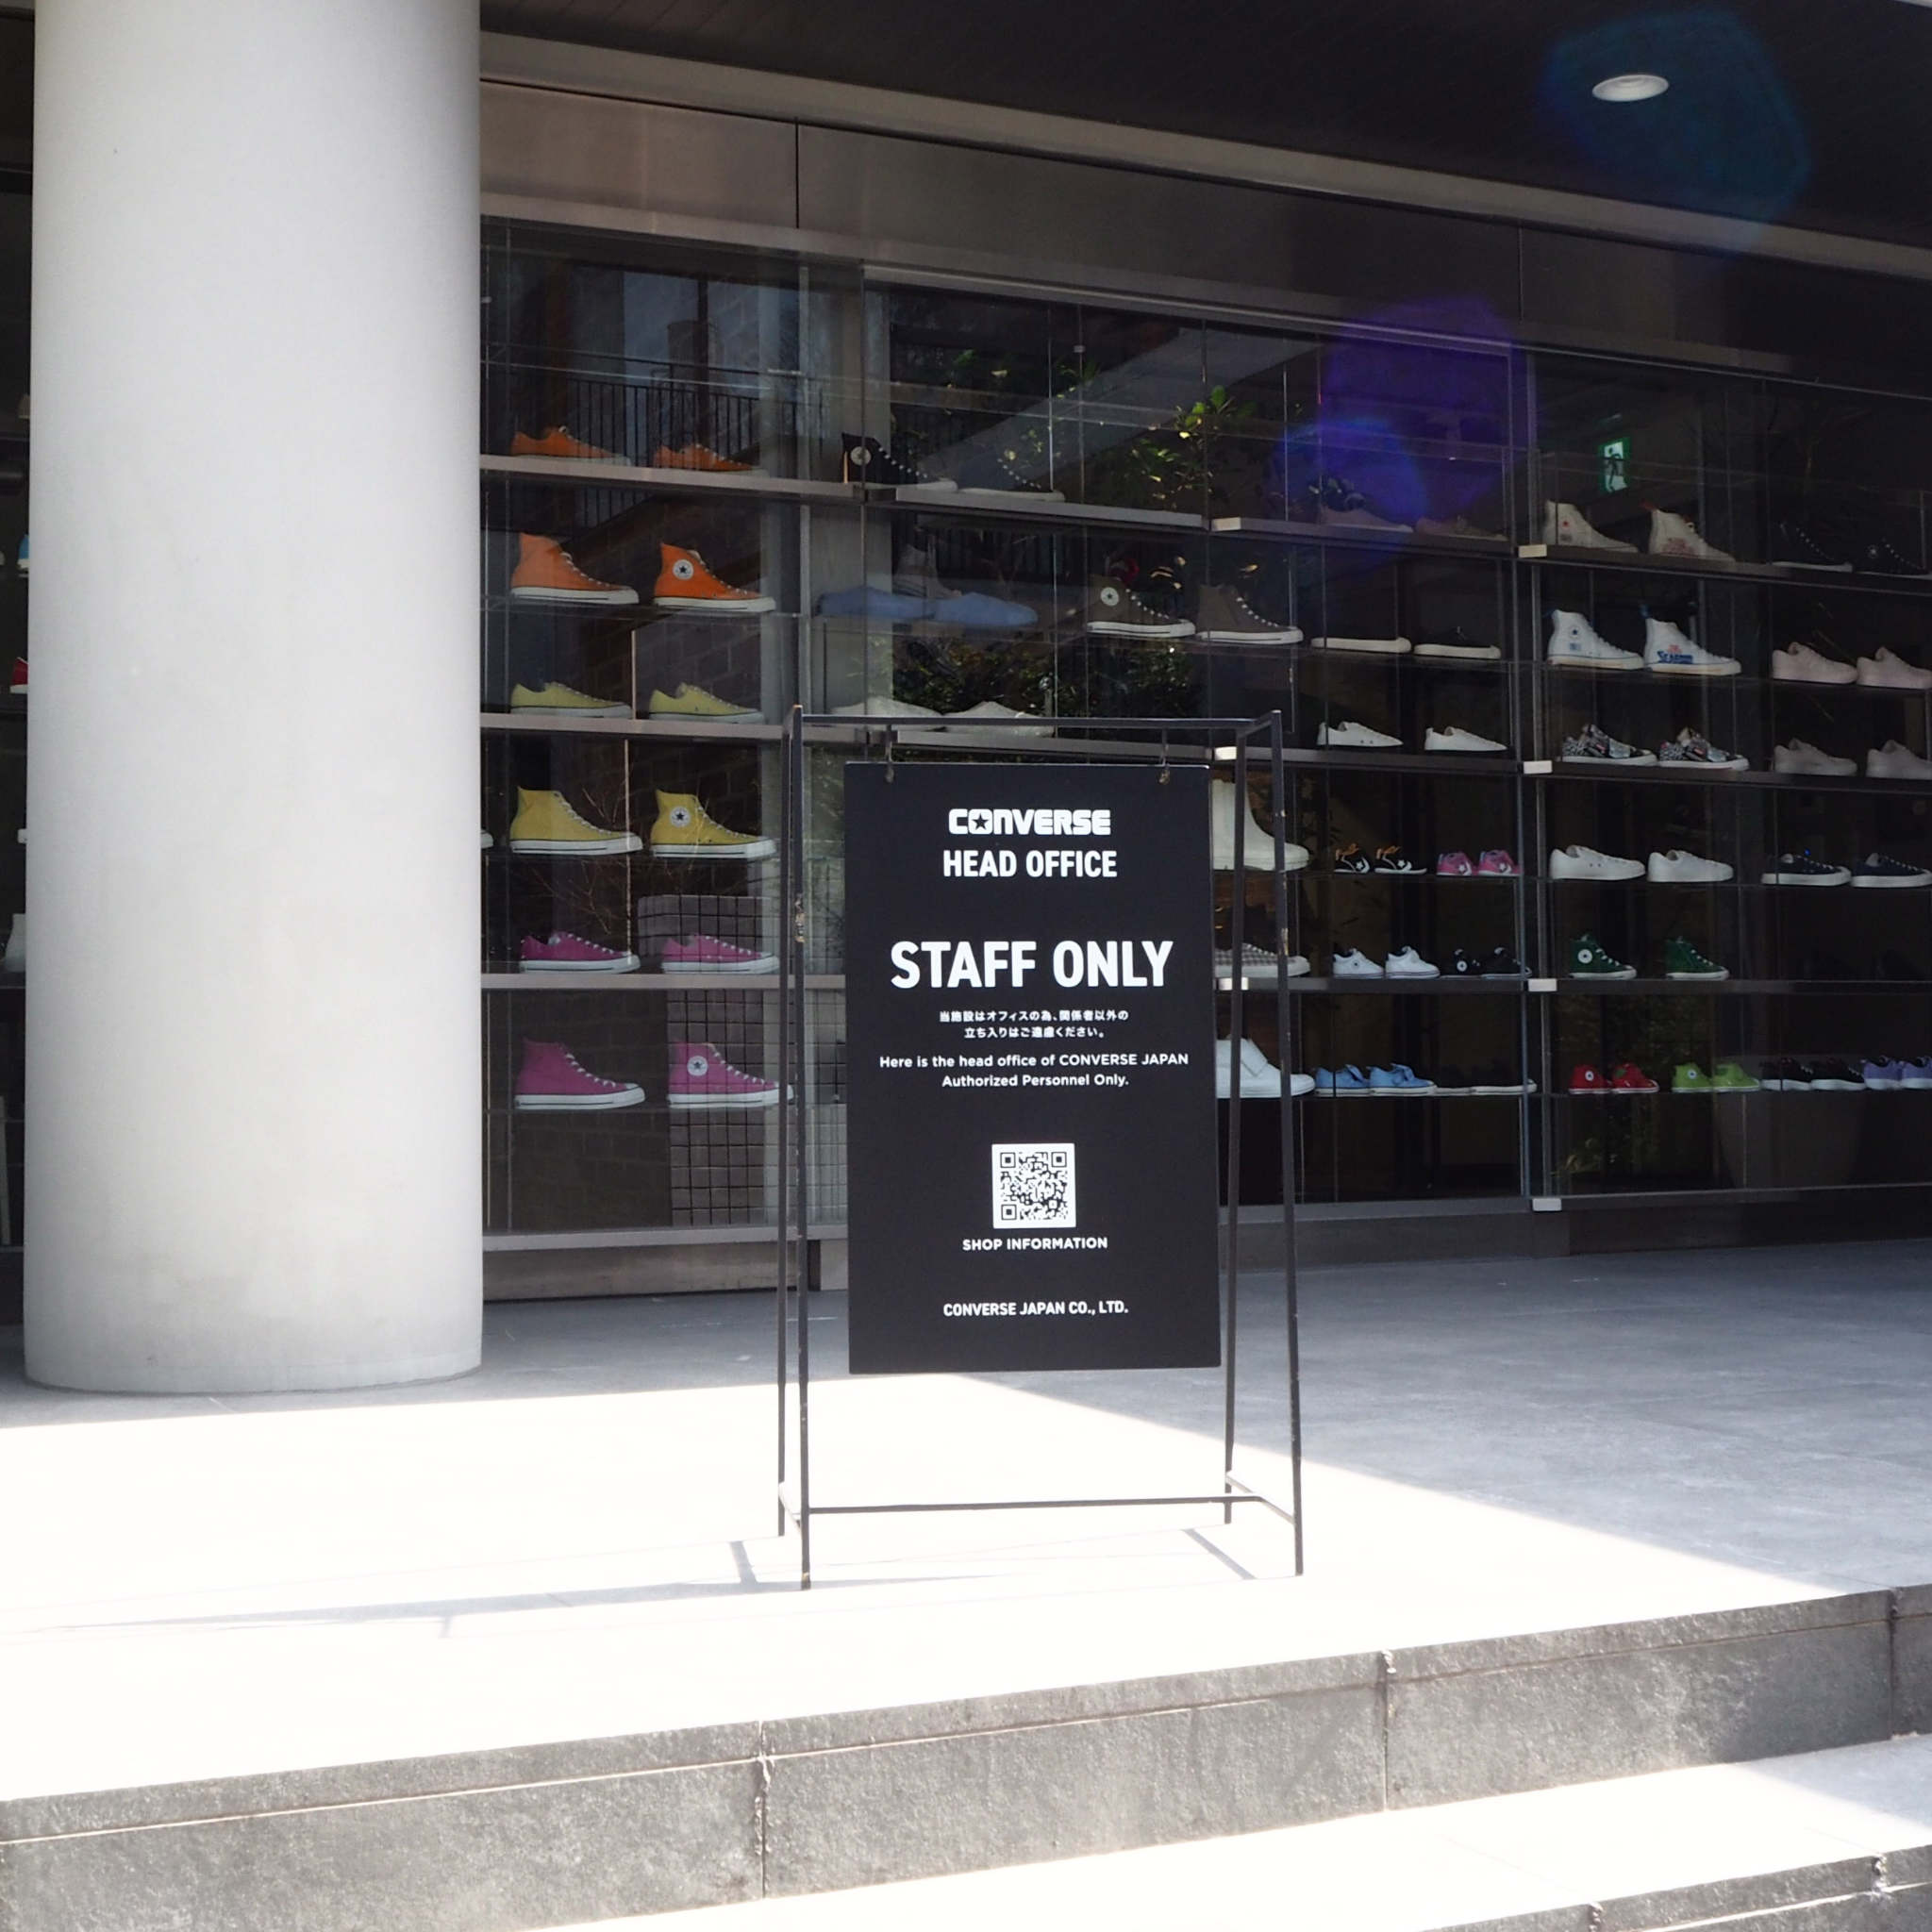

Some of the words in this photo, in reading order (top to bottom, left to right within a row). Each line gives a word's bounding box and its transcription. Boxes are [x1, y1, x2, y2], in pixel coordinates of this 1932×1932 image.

[949, 808, 1110, 835] CONVERSE
[943, 850, 1017, 876] HEAD
[1026, 850, 1117, 877] OFFICE
[891, 941, 1037, 989] STAFF
[1053, 941, 1174, 988] ONLY
[880, 1056, 912, 1068] Here
[917, 1055, 928, 1068] is
[932, 1055, 955, 1068] the
[959, 1054, 993, 1068] head
[997, 1054, 1037, 1067] office
[1041, 1054, 1056, 1067] of
[1059, 1054, 1137, 1066] CONVERSE
[1141, 1053, 1189, 1066] JAPAN
[942, 1074, 1018, 1088] Authorized
[1023, 1074, 1090, 1087] Personnel
[1094, 1073, 1129, 1088] Only.
[962, 1238, 1003, 1252] SHOP
[1007, 1237, 1108, 1251] INFORMATION
[943, 1302, 1016, 1317] CONVERSE
[1020, 1301, 1065, 1316] JAPAN
[1069, 1300, 1096, 1316] CO.,
[1099, 1300, 1129, 1314] LTD.
